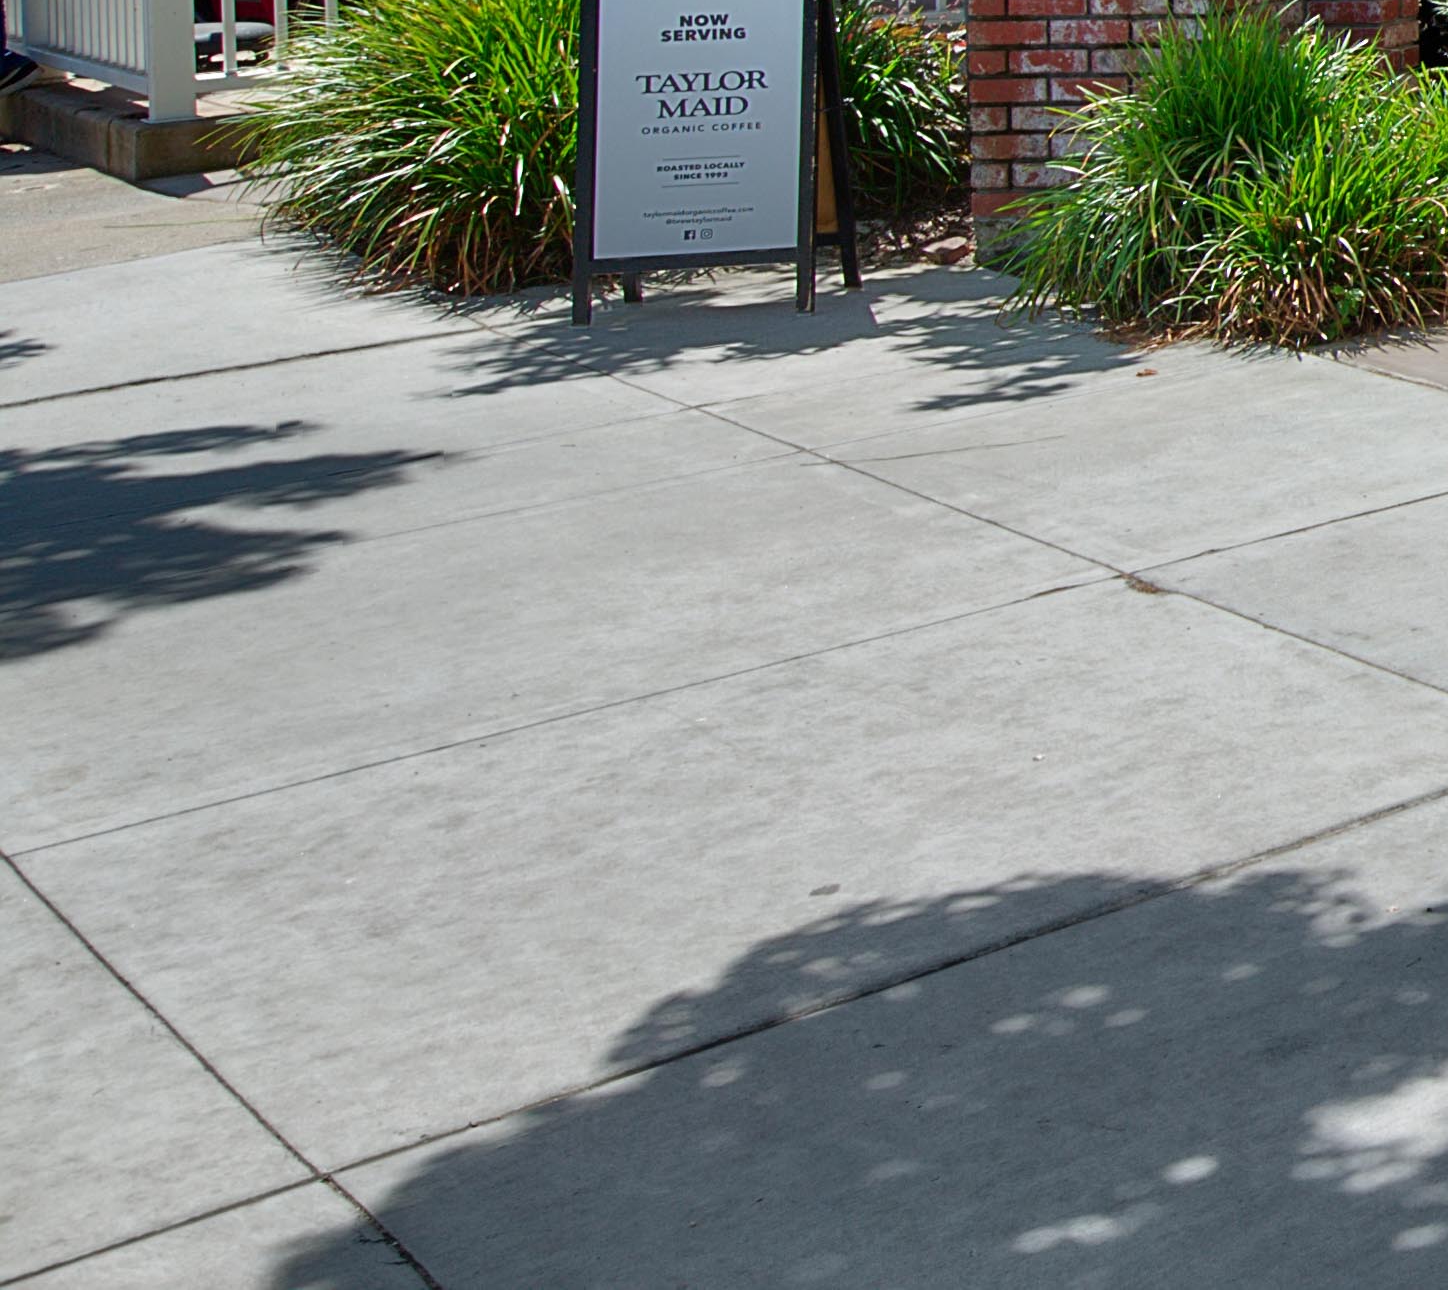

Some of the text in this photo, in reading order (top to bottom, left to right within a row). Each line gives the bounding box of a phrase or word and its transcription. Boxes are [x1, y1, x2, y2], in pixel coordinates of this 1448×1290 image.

[679, 14, 729, 27] NOW
[661, 27, 747, 42] SERVING
[636, 70, 768, 95] TAYLOR
[656, 96, 749, 119] MAID
[641, 122, 762, 135] ORGANIC COFFEE
[656, 161, 745, 172] ROASTED LOCALLY
[673, 172, 702, 180] SINCE
